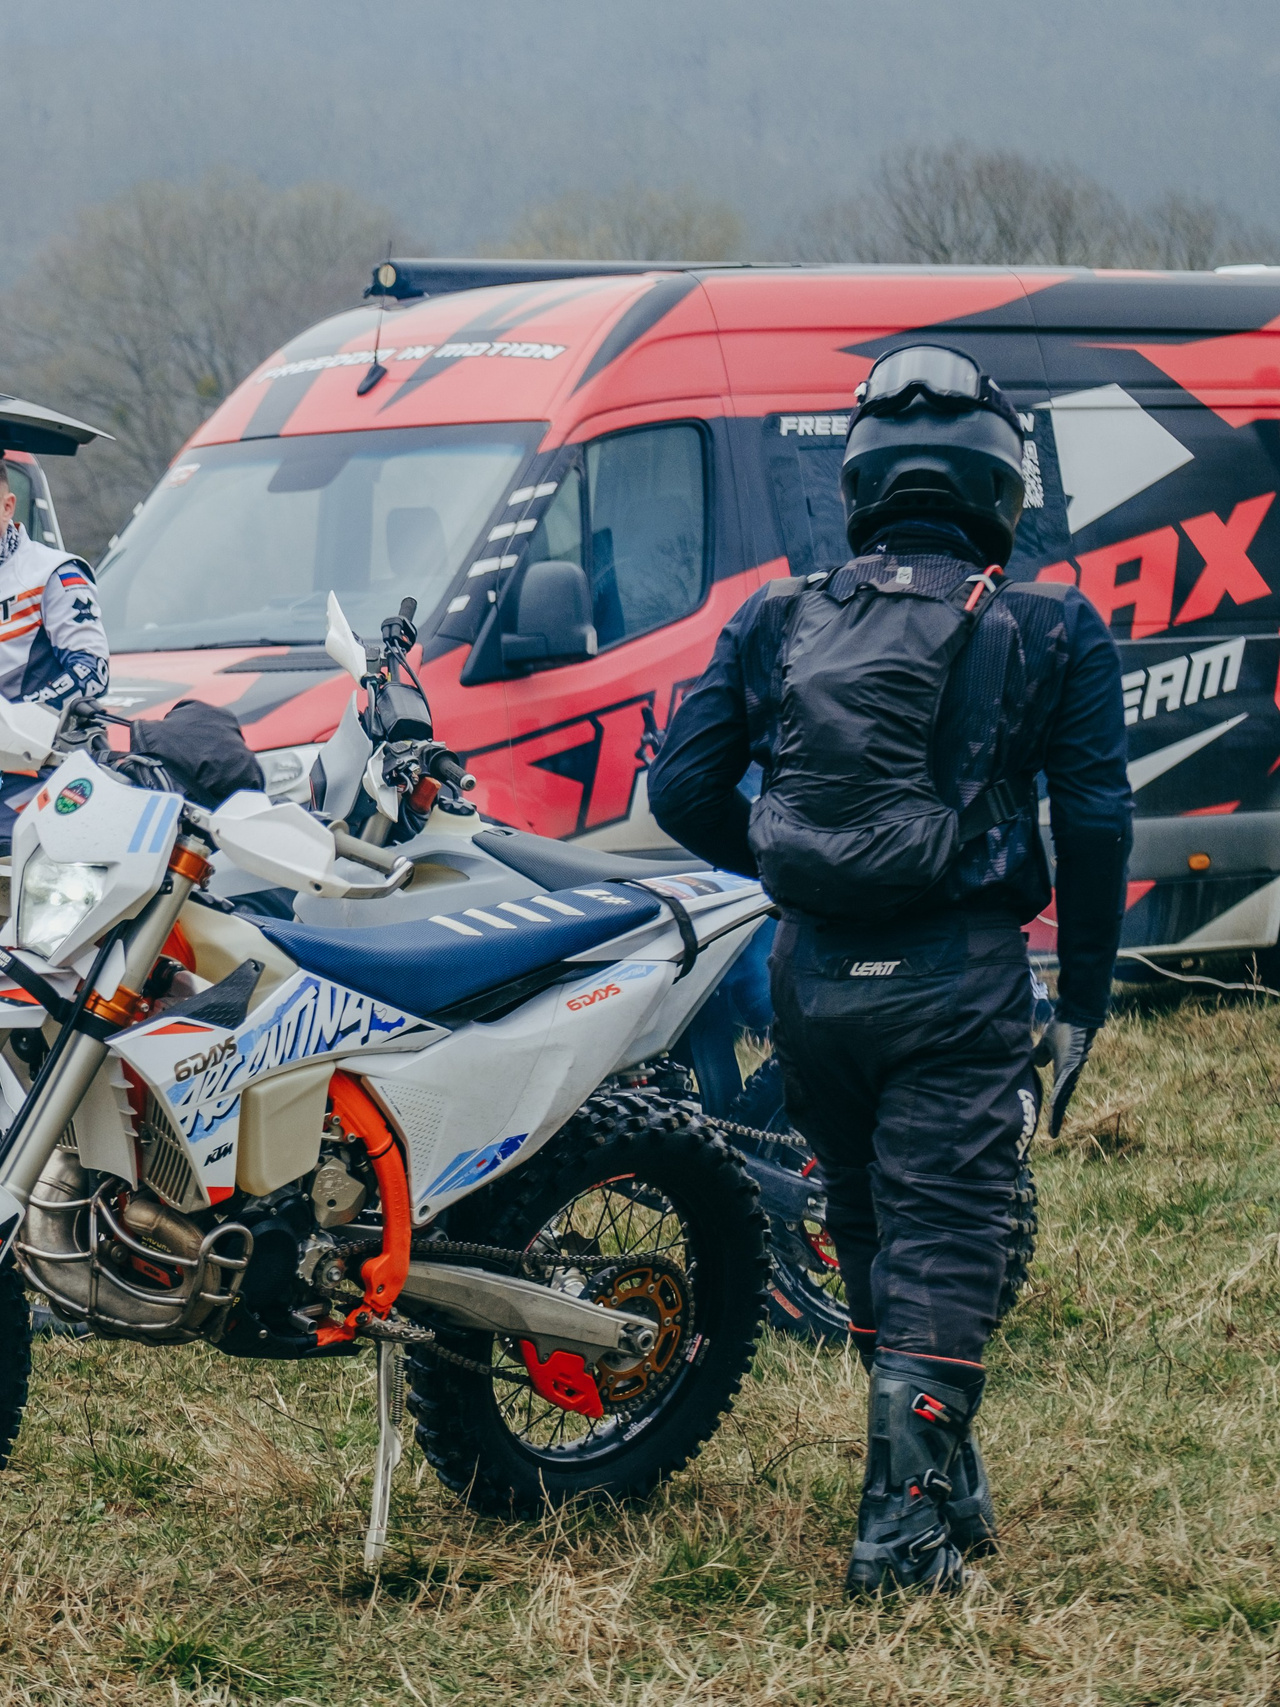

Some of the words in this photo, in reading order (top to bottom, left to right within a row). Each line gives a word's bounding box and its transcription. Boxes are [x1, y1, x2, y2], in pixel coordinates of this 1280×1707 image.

[256, 349, 396, 384] FREEDOM
[396, 345, 433, 361] IN
[434, 342, 567, 360] MOTION
[1121, 636, 1246, 726] EAM
[849, 961, 901, 977] LEATT
[566, 983, 622, 1012] 6DAYS
[173, 1035, 238, 1082] 6DAYS
[204, 1142, 234, 1167] KTM
